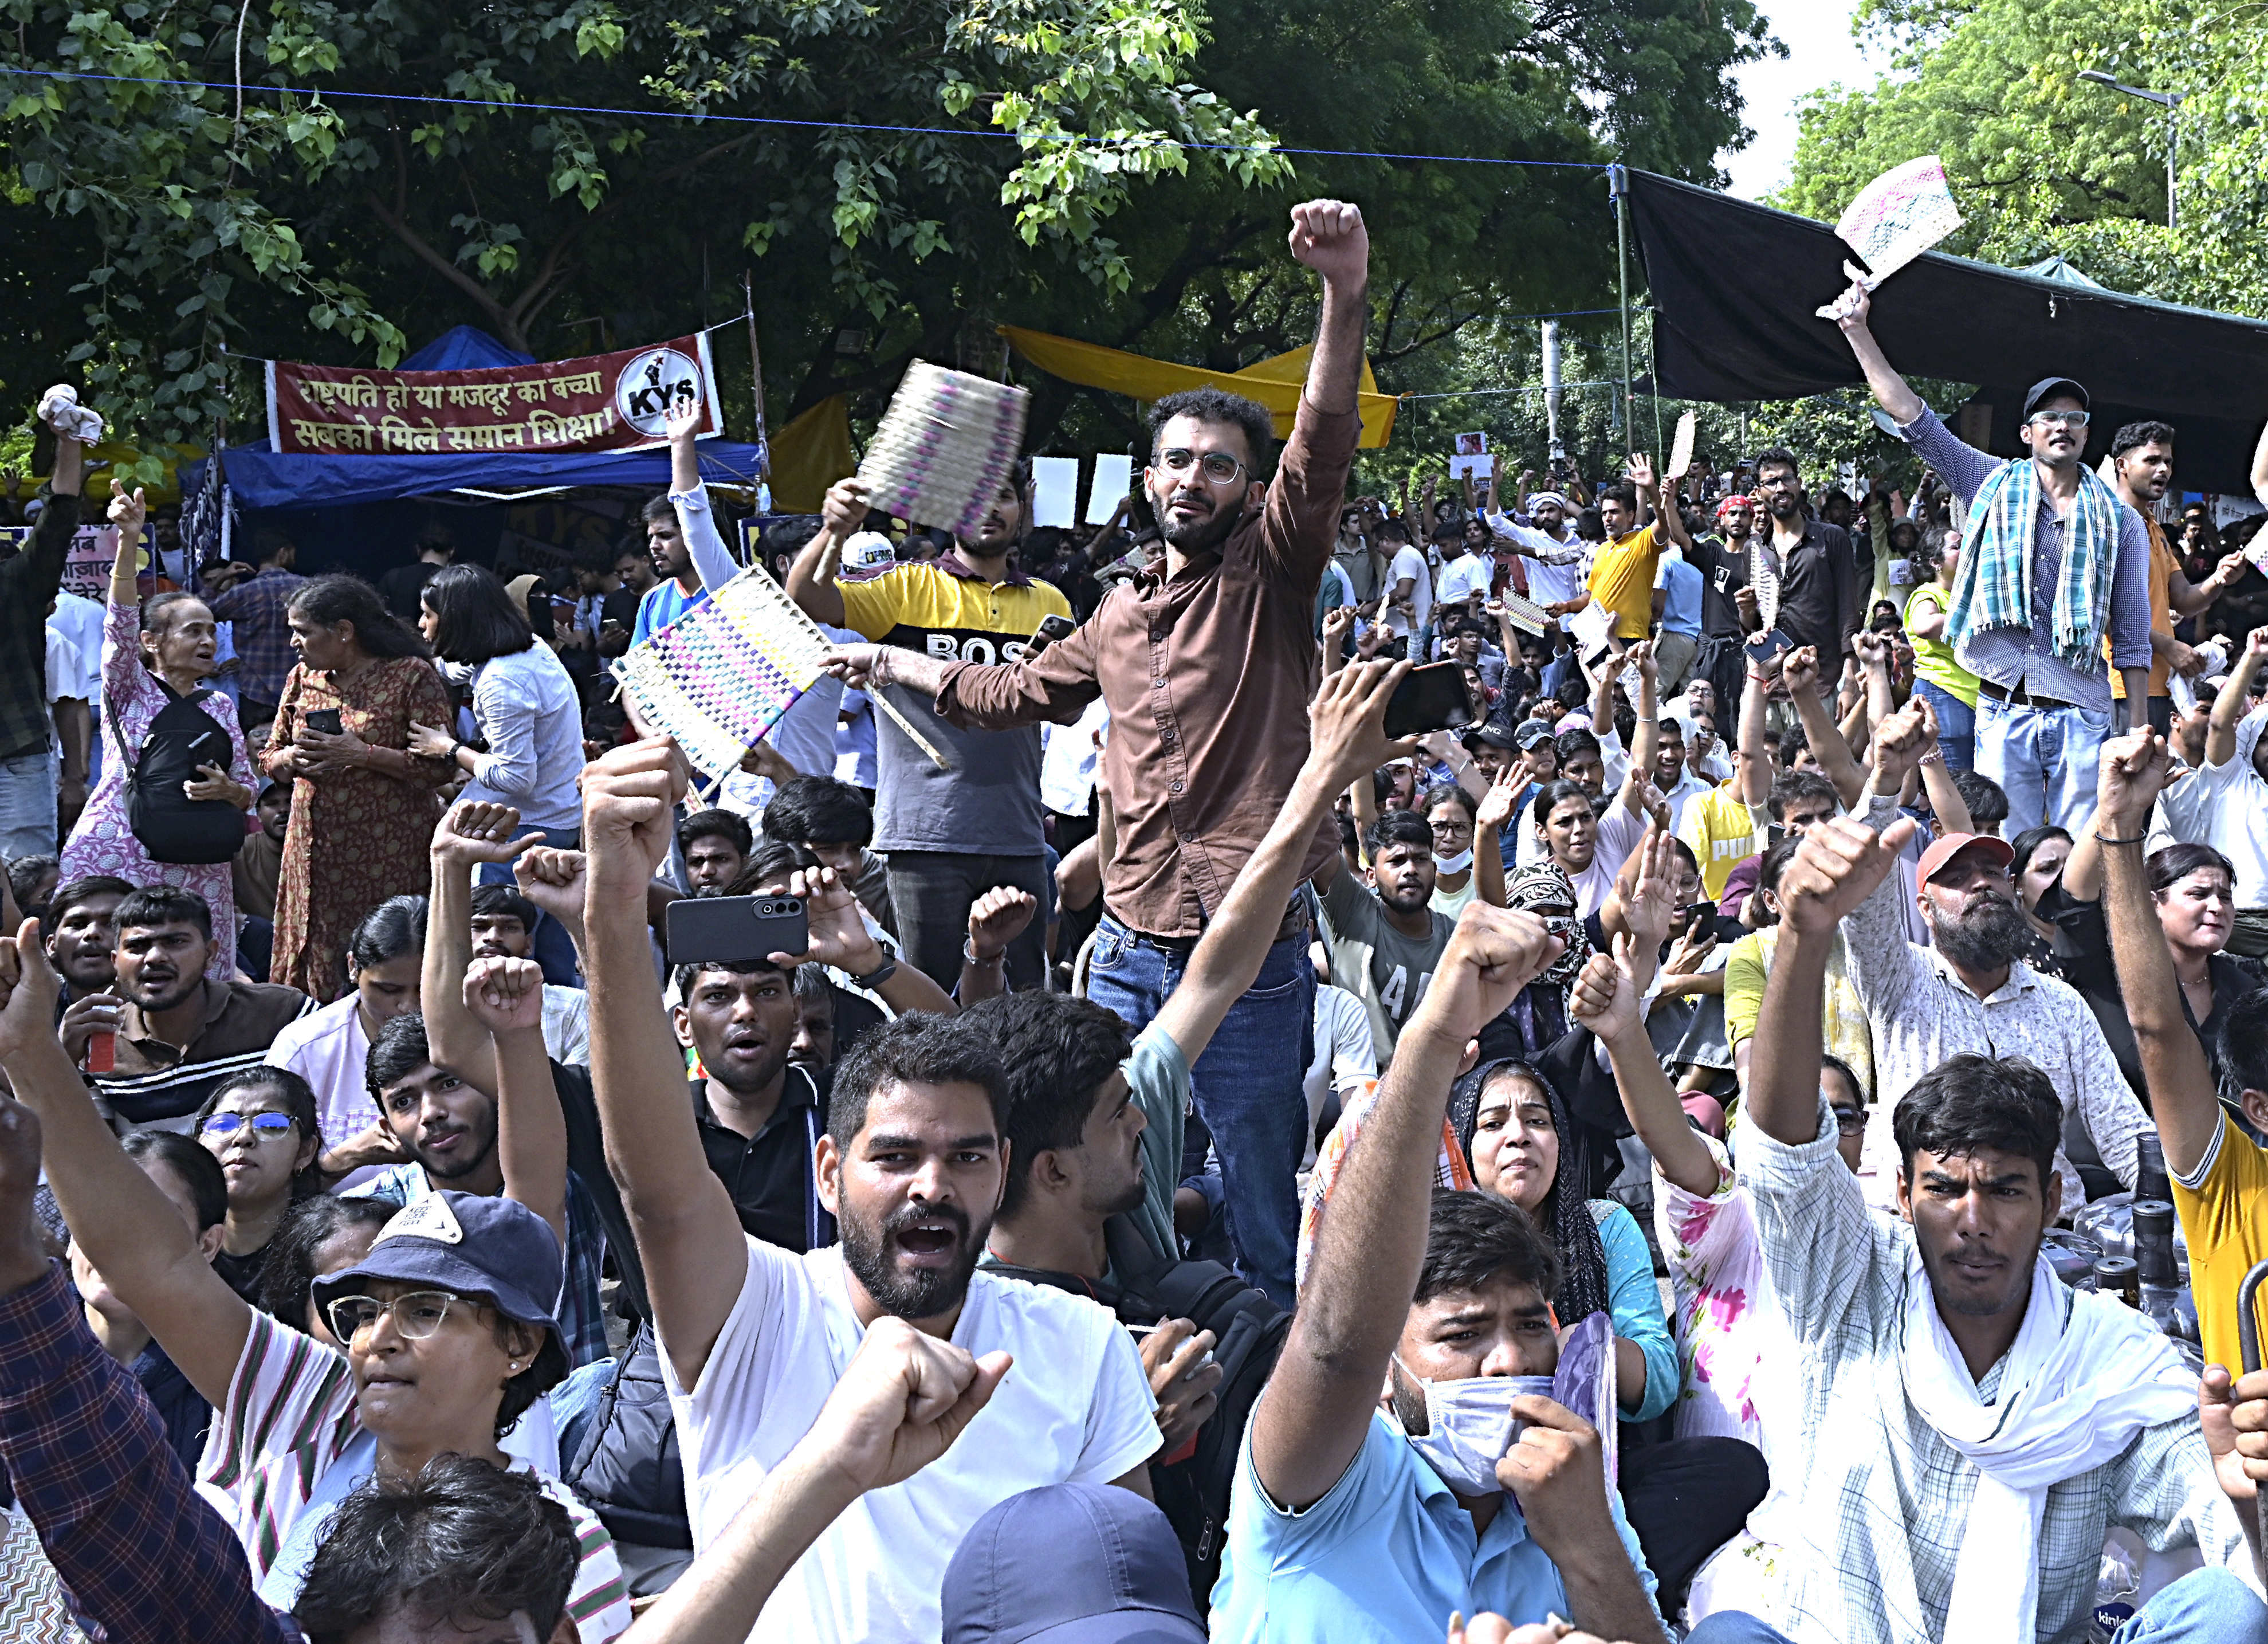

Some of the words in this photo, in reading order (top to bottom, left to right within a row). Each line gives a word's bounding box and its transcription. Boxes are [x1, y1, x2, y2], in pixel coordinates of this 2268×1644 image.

[297, 375, 380, 413] राष्ट्रपति
[383, 377, 410, 412] हो
[412, 385, 445, 409] या
[446, 383, 512, 417] मजदूर
[513, 379, 547, 403] का
[548, 371, 602, 399] बच्चा
[628, 379, 695, 417] KYS
[289, 414, 375, 451] सबको
[376, 415, 443, 452] मिले
[443, 422, 525, 450] समान
[526, 407, 616, 445] शिक्षा!
[1712, 836, 1755, 861] PU
[2098, 1611, 2127, 1627] kinle
